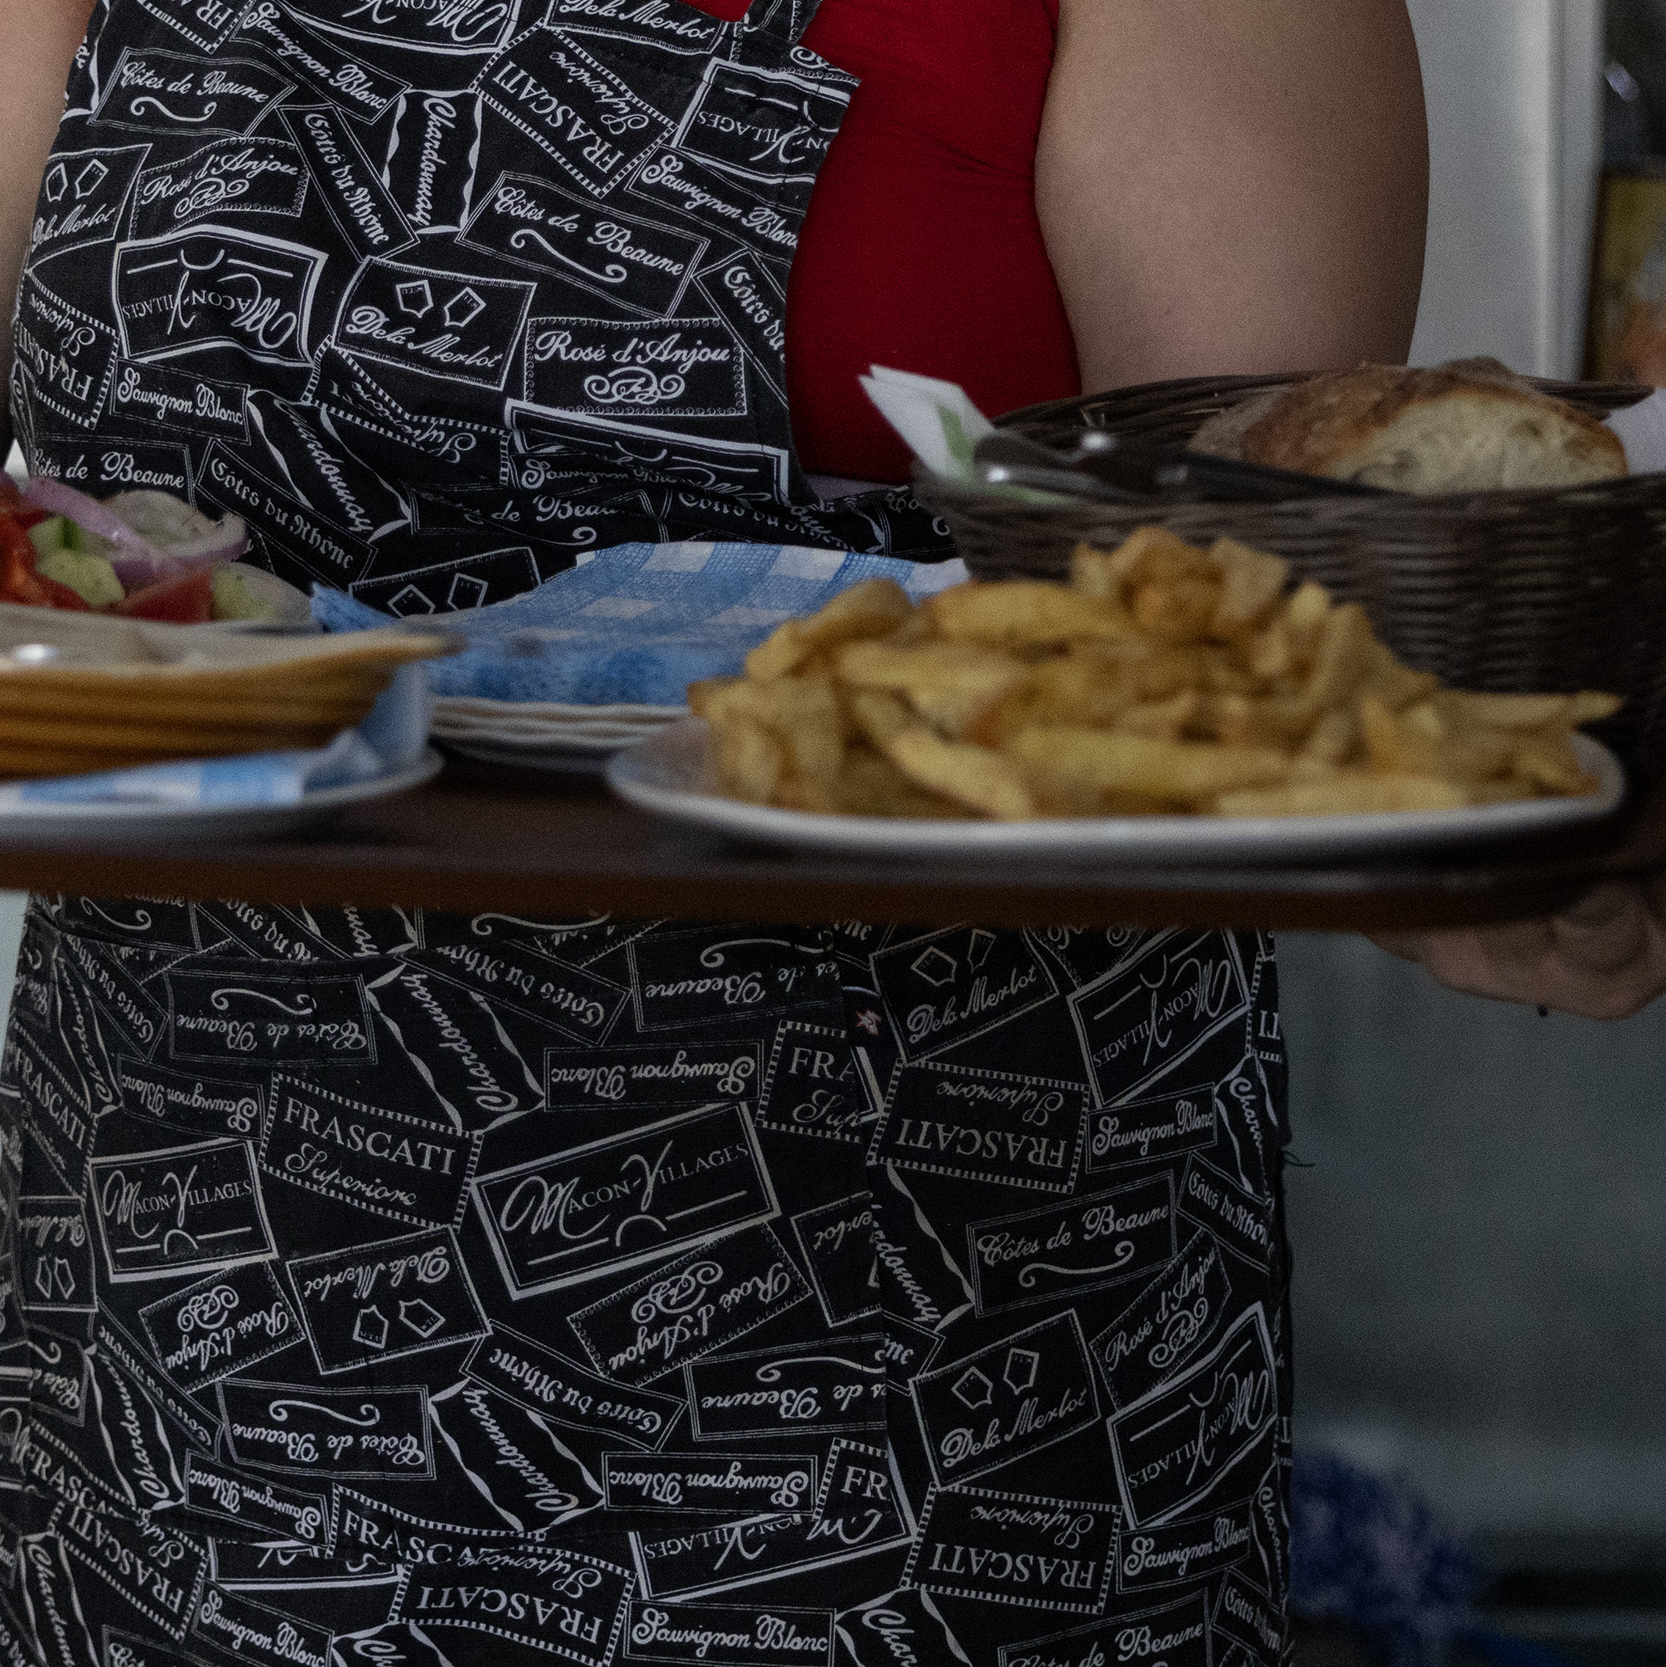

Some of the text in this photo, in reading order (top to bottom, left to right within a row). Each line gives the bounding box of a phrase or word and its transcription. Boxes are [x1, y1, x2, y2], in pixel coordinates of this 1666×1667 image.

[621, 0, 716, 40] Merlot
[242, 1, 389, 110] Sauvignon Blanc
[122, 62, 270, 104] Côtes de Beaune
[493, 61, 624, 173] FRASCATI
[141, 148, 300, 206] Rosé d'Anjou
[330, 165, 355, 190] du
[407, 98, 457, 227] Chardonnay
[641, 154, 743, 219] Sauvignon
[493, 185, 684, 276] Côtes de Beaune
[346, 305, 504, 368] Dela Merlot
[535, 330, 731, 373] Rosé d'Anjou
[117, 367, 244, 426] Sauvignon Blanc
[64, 454, 90, 481] de
[100, 451, 186, 489] Beaune
[265, 498, 289, 527] du
[491, 499, 522, 523] de
[505, 966, 536, 996] du
[644, 970, 767, 1005] Beaune
[906, 966, 1039, 1044] Dela Merlot
[176, 1013, 368, 1051] Côtes de Beaune
[400, 972, 519, 1112] Chardonnay
[550, 1063, 627, 1100] Blanc
[631, 1050, 755, 1095] Sauvignon
[120, 1074, 258, 1132] Sauvignon Blanc
[1092, 1098, 1215, 1157] Sauvignon Blanc
[282, 1096, 458, 1175] FRASCATI
[894, 1117, 1069, 1170] FRASCATI
[813, 1210, 874, 1252] erlot
[976, 1204, 1170, 1267] Côtes de Beaune
[303, 1245, 451, 1302] Dela Merlot
[165, 1299, 290, 1373] Rosé d'Anjou
[607, 1262, 792, 1373] Rosé d'Anjou
[1104, 1316, 1154, 1373] Rosé
[562, 1390, 594, 1417] du
[701, 1385, 822, 1419] Beaune
[832, 1383, 864, 1412] de
[232, 1422, 427, 1467] Côtes de Beaune
[462, 1387, 580, 1513] Chardonnay
[940, 1385, 1088, 1469] Dela Merlot
[188, 1469, 242, 1513] Blanc
[609, 1470, 684, 1505] Blanc
[684, 1461, 811, 1508] Sauvignon
[241, 1486, 321, 1540] Sauvignon
[928, 1542, 1098, 1590] FRASCATI
[1123, 1536, 1214, 1577] Sauvignon
[200, 1589, 275, 1651] Sauvignon
[415, 1585, 604, 1645] FRASCATI
[633, 1607, 751, 1658] Sauvignon
[753, 1613, 829, 1653] Blanc
[1113, 1621, 1205, 1663] Beaune
